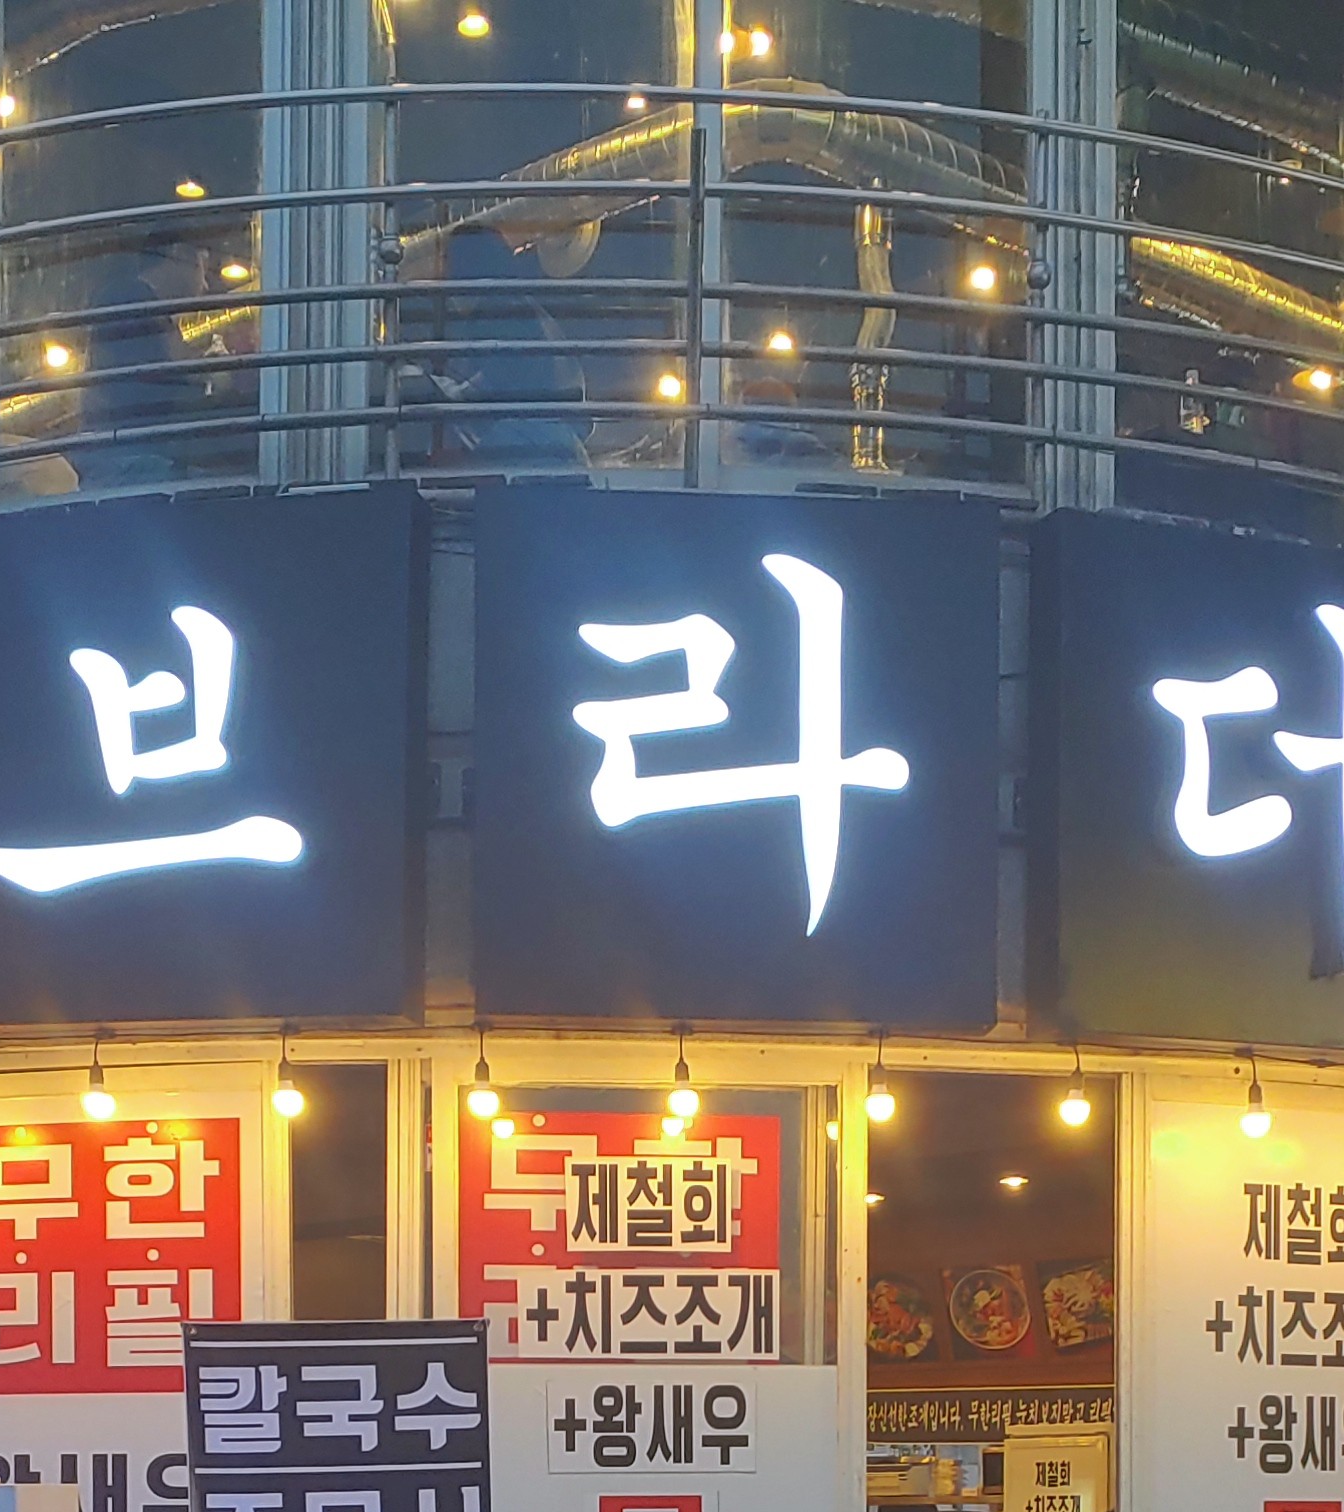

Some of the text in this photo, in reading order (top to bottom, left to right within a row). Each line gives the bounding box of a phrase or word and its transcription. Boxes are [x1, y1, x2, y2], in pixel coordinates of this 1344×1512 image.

[569, 1158, 729, 1248] 제철회
[525, 1271, 777, 1357] +치즈조개
[198, 1361, 482, 1455] 칼국수
[553, 1384, 750, 1468] +왕새우
[1035, 1461, 1071, 1487] 제철회
